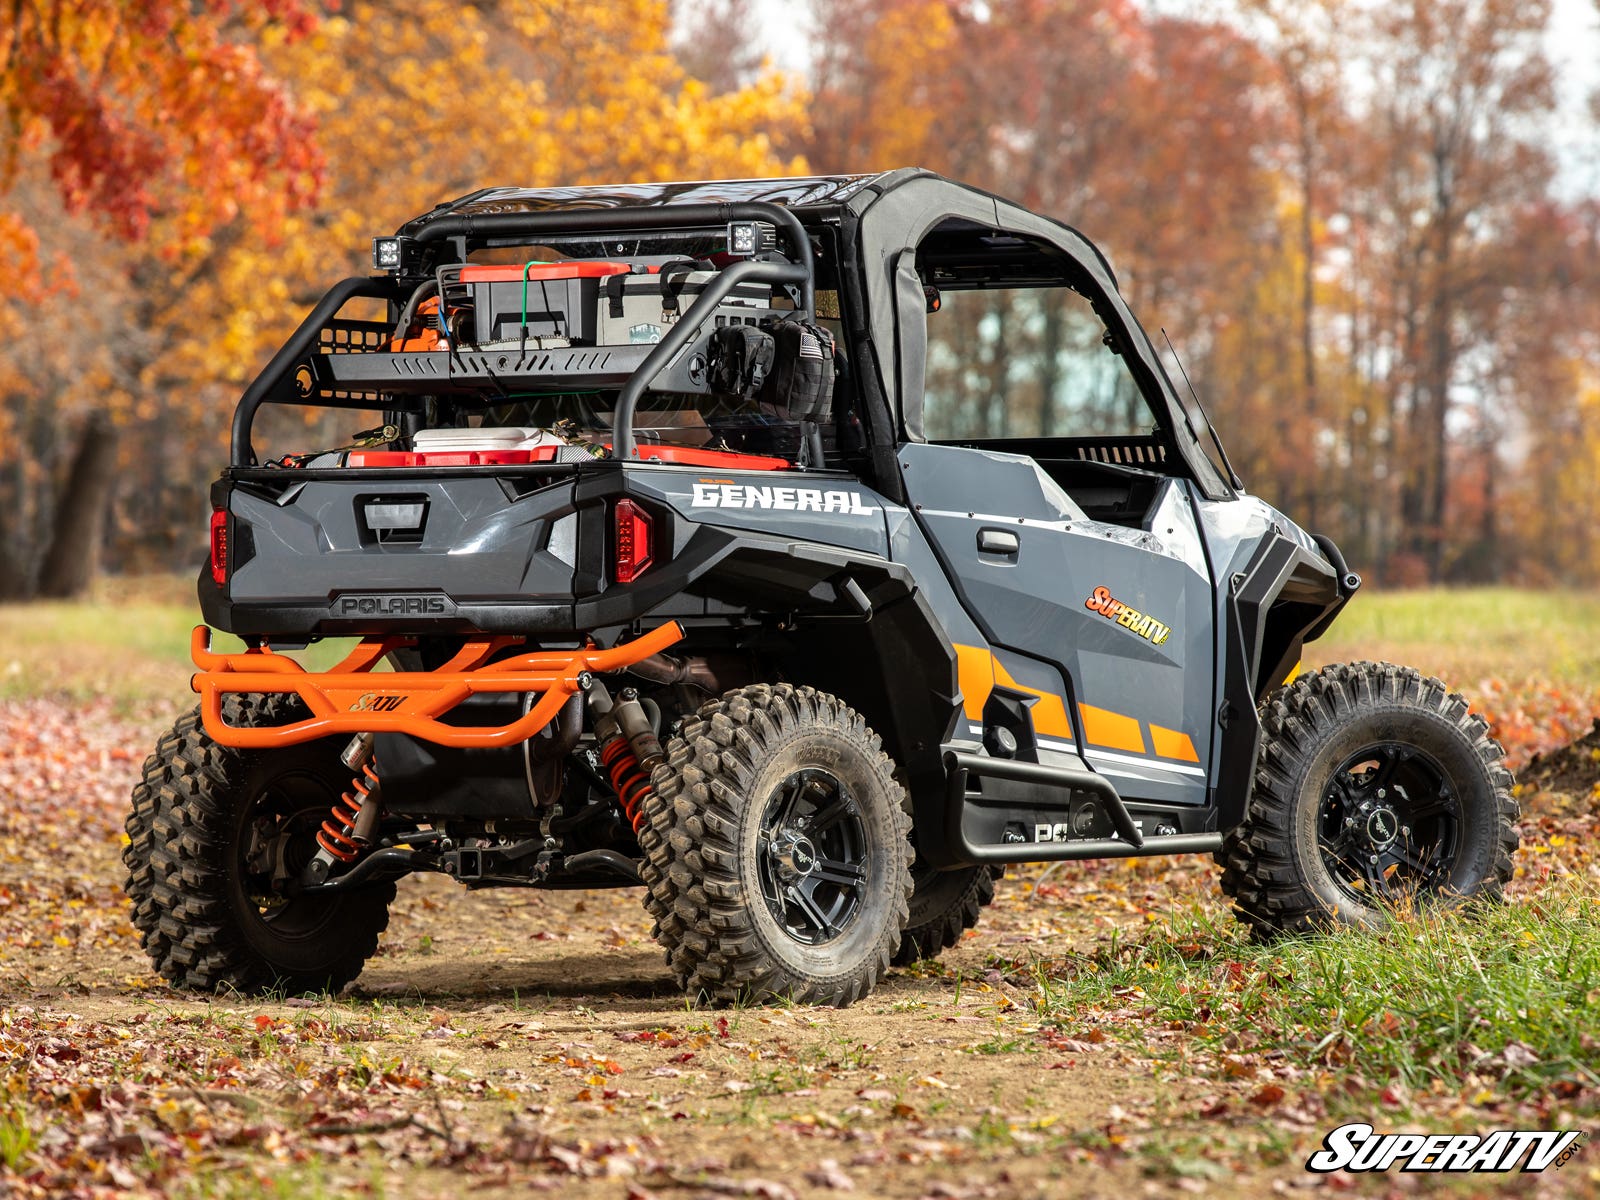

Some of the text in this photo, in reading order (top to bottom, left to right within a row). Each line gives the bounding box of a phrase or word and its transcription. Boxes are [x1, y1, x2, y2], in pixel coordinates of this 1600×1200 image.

[691, 483, 873, 516] GENERAL
[341, 597, 445, 615] POLARIS
[1084, 586, 1170, 646] SUPERATV
